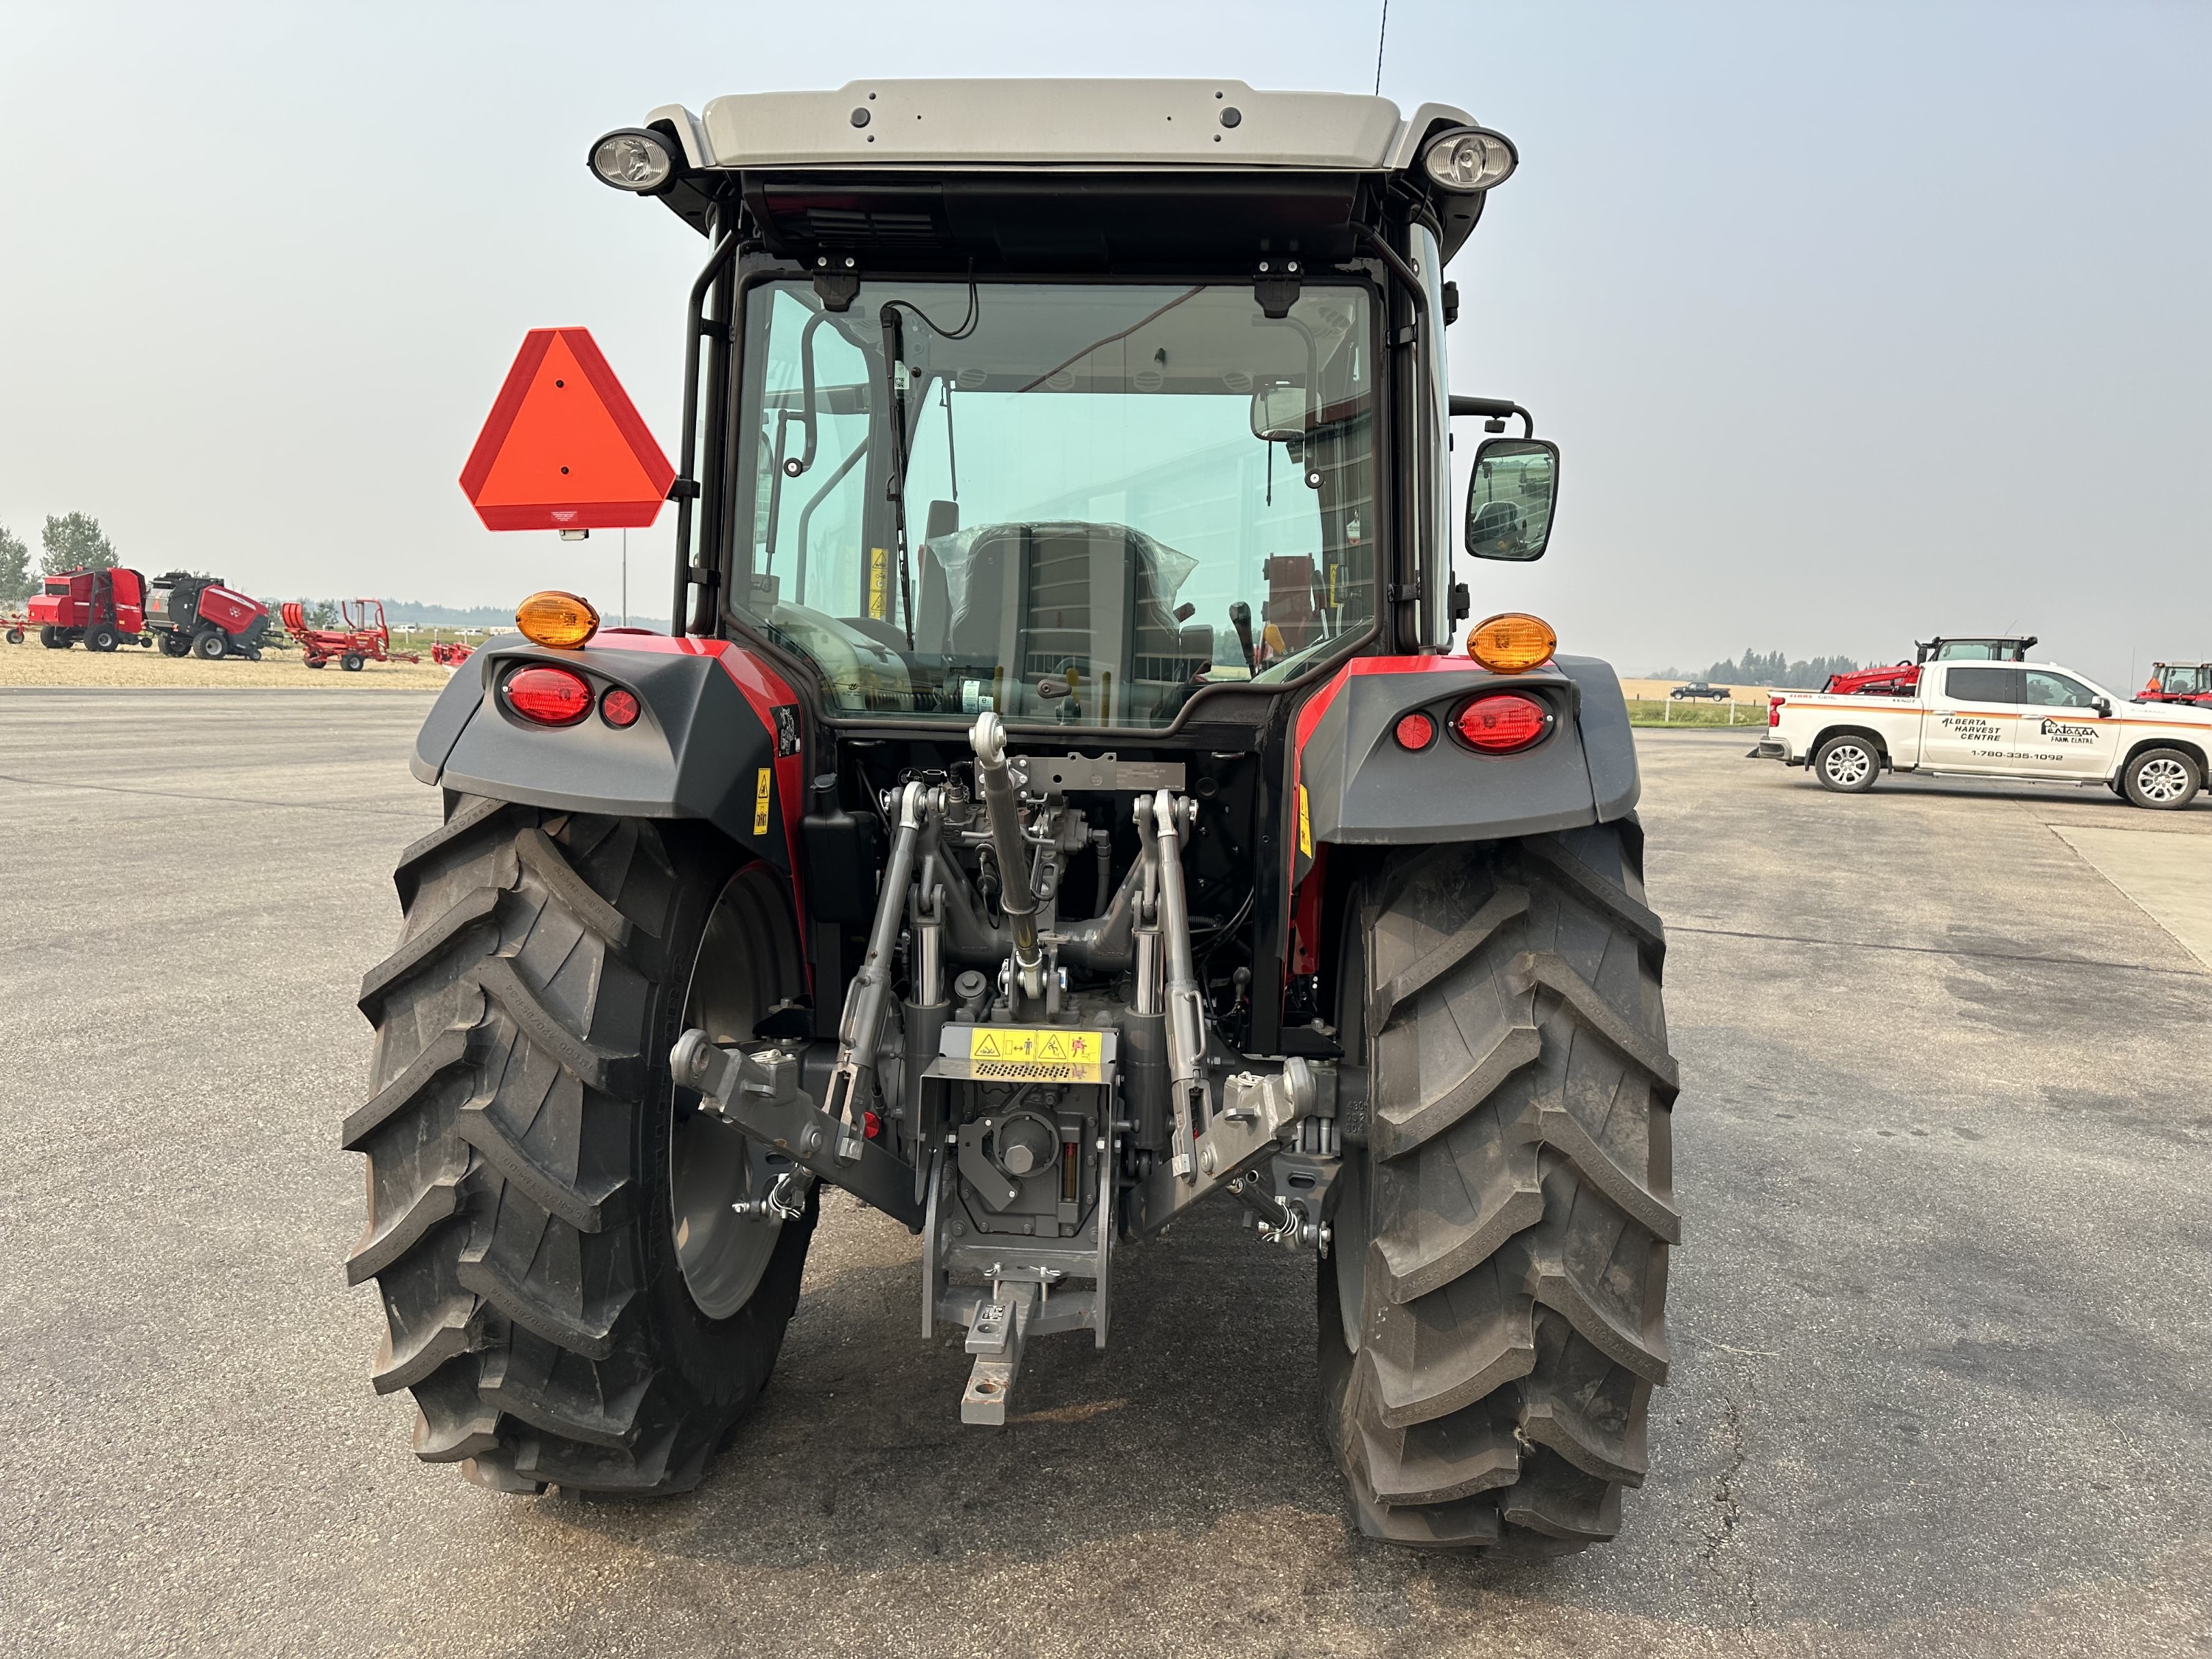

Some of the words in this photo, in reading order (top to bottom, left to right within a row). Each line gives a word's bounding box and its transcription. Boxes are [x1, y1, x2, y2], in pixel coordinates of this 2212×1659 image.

[1942, 717, 1986, 727] ALBERTA
[1955, 726, 2001, 734] HARVEST
[1961, 733, 2001, 742] CENTRE
[1972, 750, 2063, 761] 1-780-335-1092
